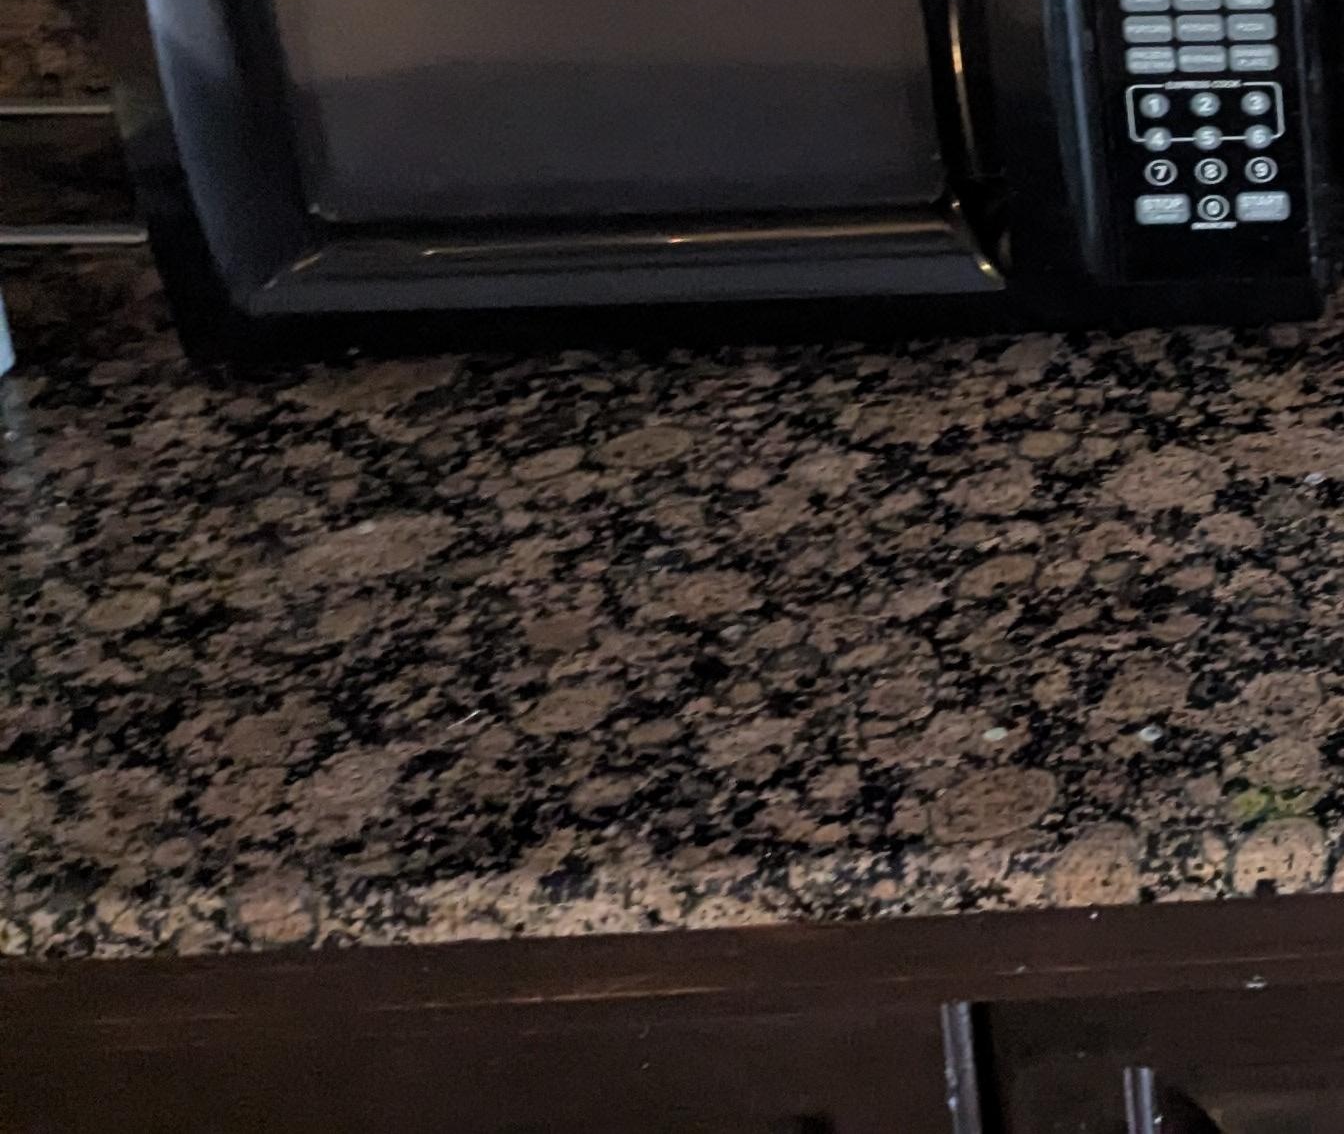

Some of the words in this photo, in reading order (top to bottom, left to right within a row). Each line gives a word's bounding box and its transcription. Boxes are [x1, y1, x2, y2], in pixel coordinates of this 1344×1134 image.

[1200, 97, 1212, 111] 2
[1250, 95, 1262, 109] 3
[1152, 131, 1164, 145] 4
[1202, 130, 1214, 144] 5
[1253, 129, 1265, 143] 6
[1154, 165, 1167, 179] 7
[1203, 164, 1218, 179] 8
[1254, 163, 1268, 177] 9
